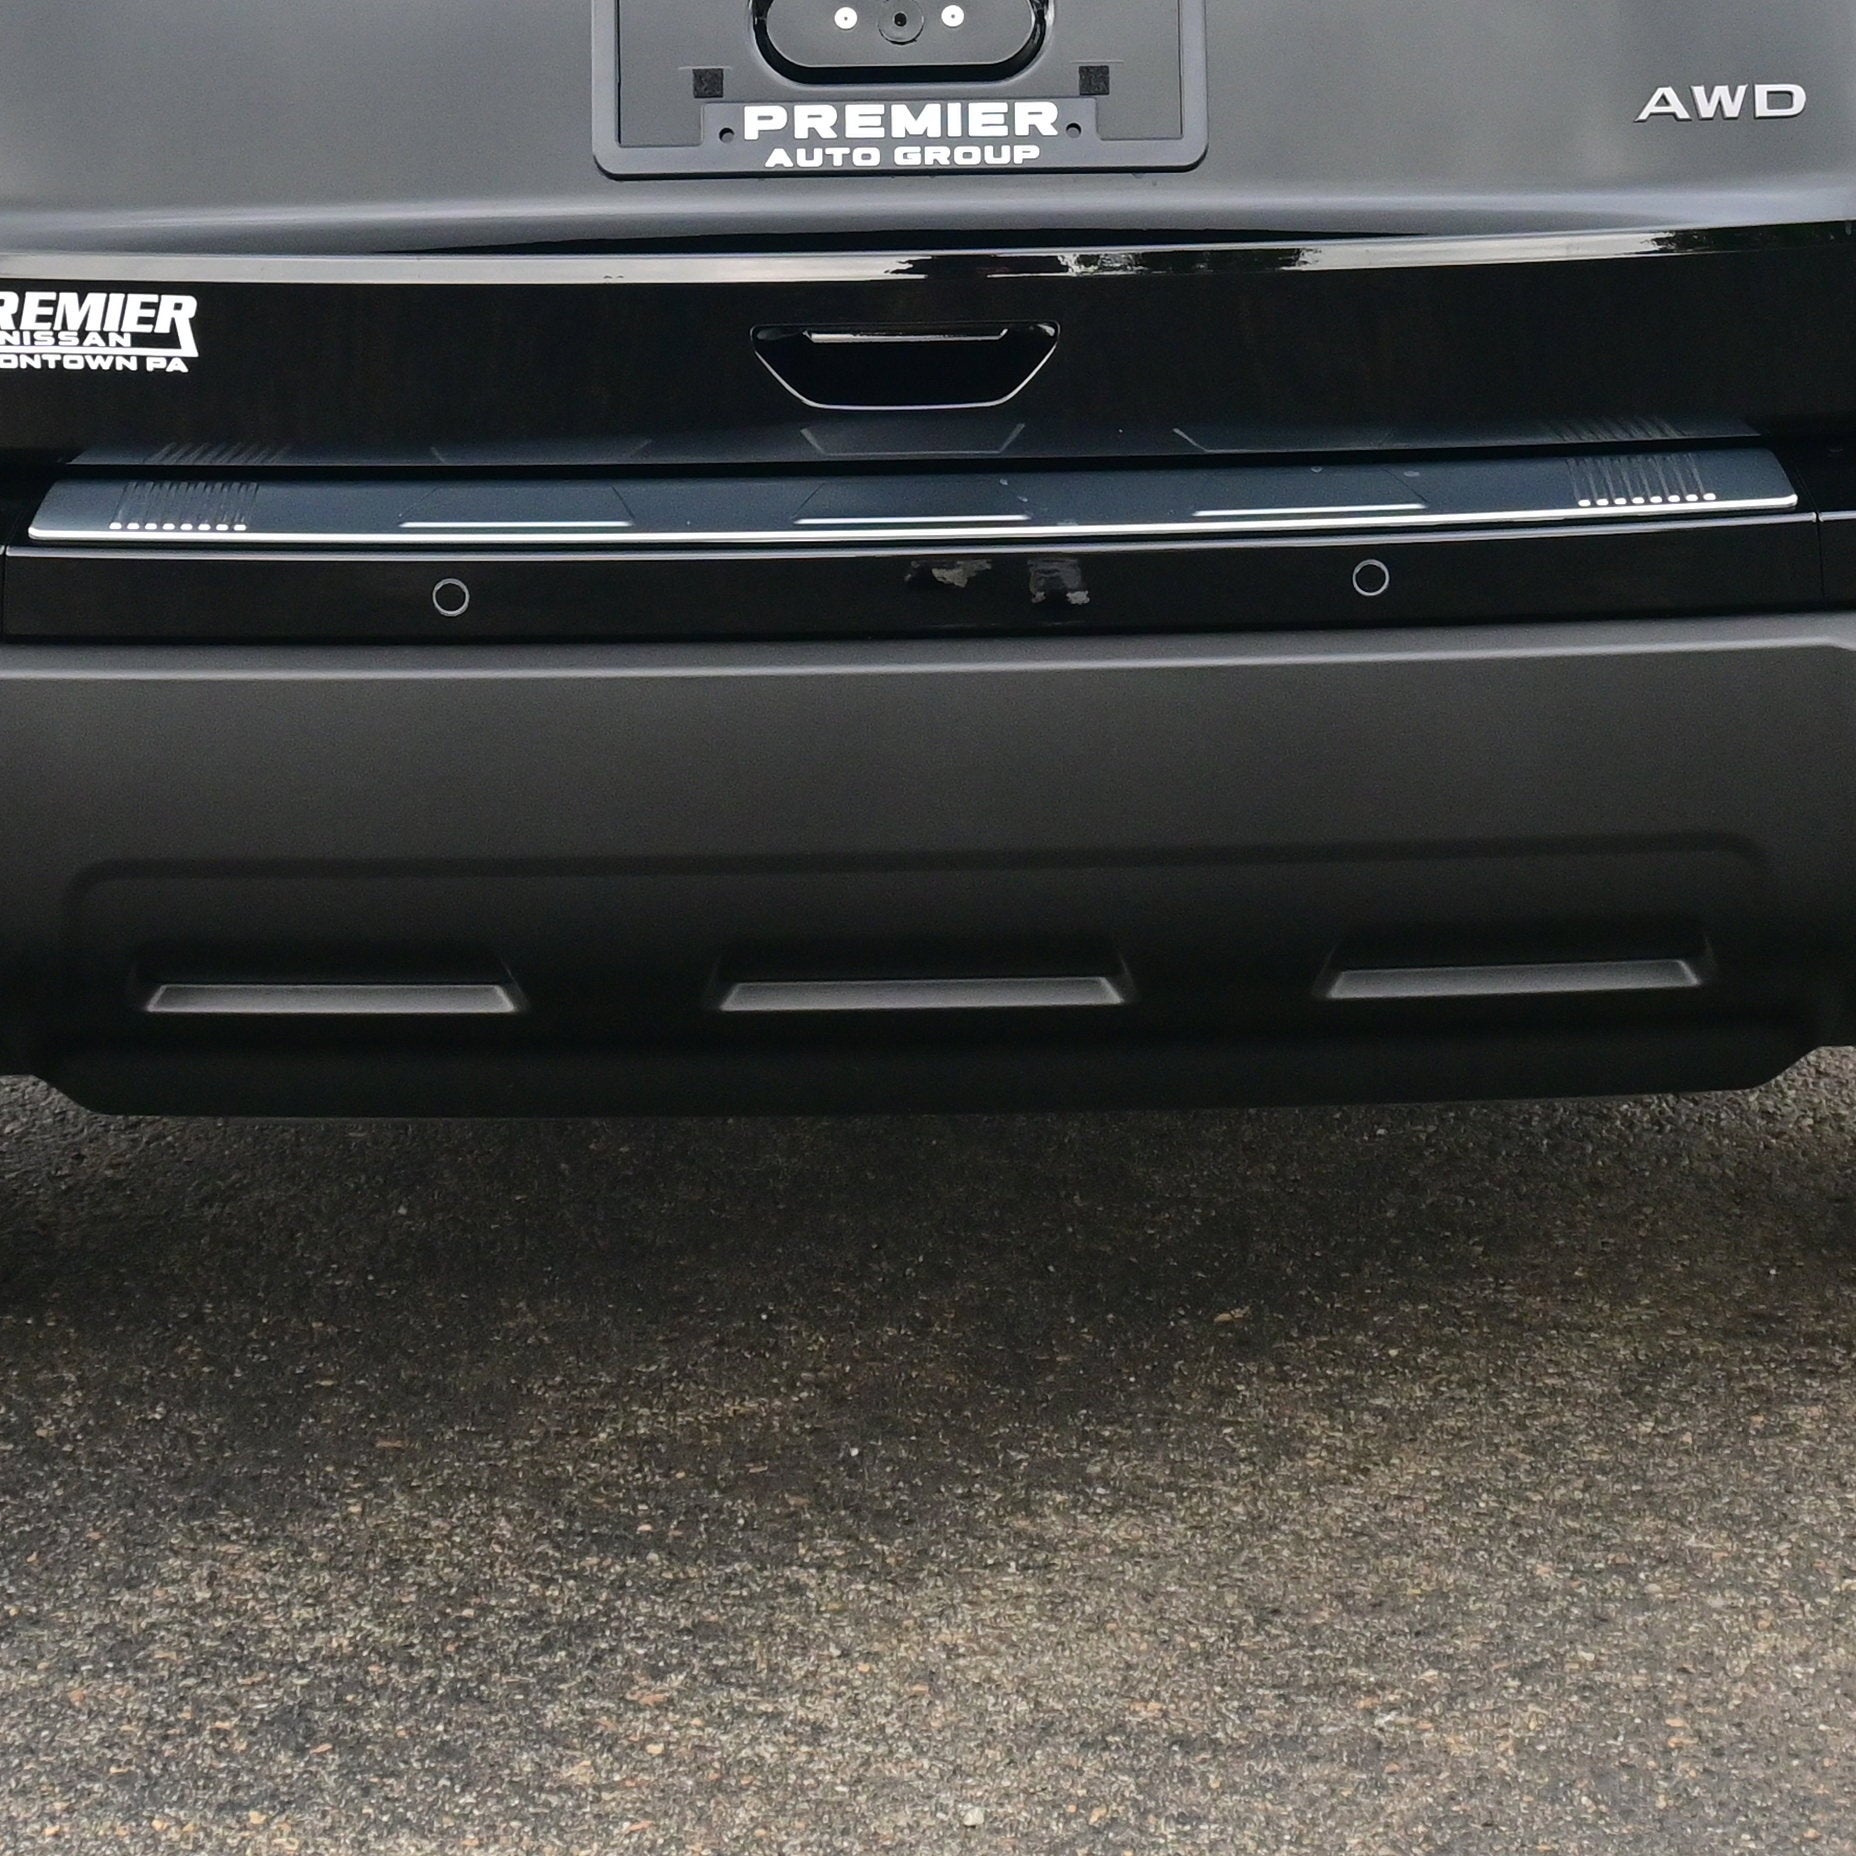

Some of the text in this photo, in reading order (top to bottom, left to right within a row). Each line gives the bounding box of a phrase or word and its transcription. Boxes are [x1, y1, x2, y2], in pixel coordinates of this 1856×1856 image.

[1633, 83, 1807, 122] AWD
[744, 101, 1059, 141] PREMIER
[764, 144, 1041, 168] AUTO GROUP
[145, 356, 190, 373] PA
